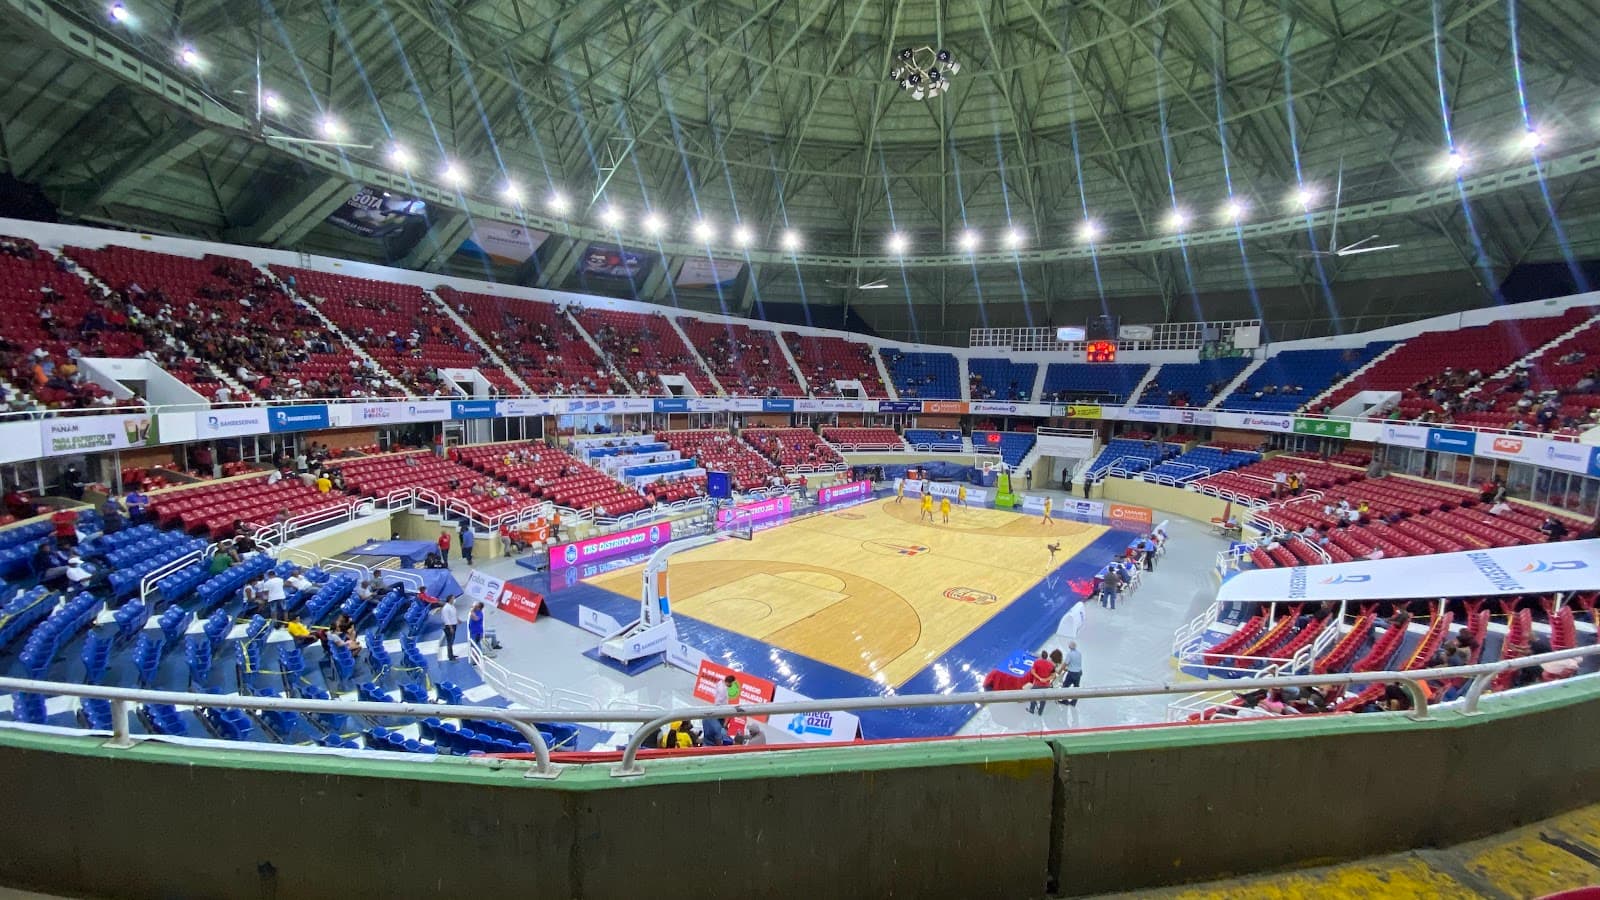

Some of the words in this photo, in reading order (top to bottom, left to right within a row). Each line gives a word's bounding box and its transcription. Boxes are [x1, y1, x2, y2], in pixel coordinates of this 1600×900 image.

[352, 191, 383, 209] GOTA
[51, 425, 79, 433] PANAM
[599, 537, 630, 551] DISTRITO
[742, 682, 761, 695] PRECIO
[740, 690, 762, 703] CALIDAD
[807, 716, 833, 728] azul
